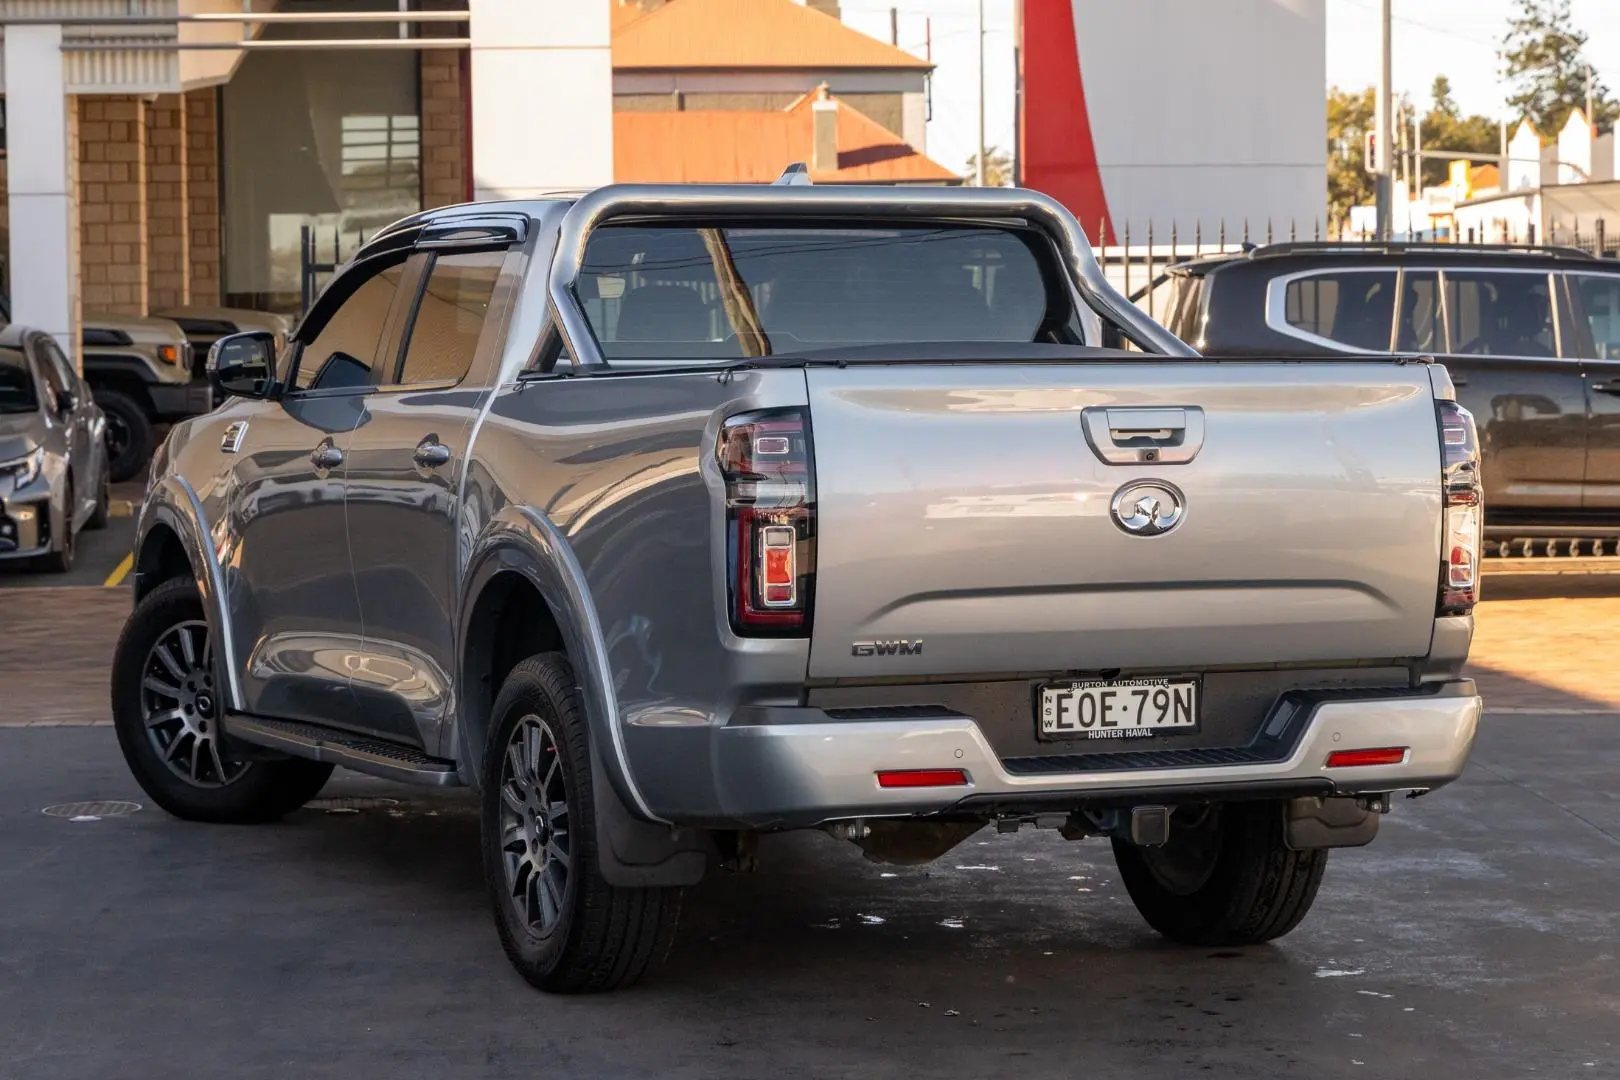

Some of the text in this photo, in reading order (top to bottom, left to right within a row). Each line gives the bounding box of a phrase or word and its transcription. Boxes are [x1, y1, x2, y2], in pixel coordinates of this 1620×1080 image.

[852, 639, 923, 656] GWM
[1072, 678, 1169, 689] BURTON AUTOMOTIVE
[1044, 696, 1053, 728] NSW
[1088, 728, 1152, 739] HUNTER HAVAL
